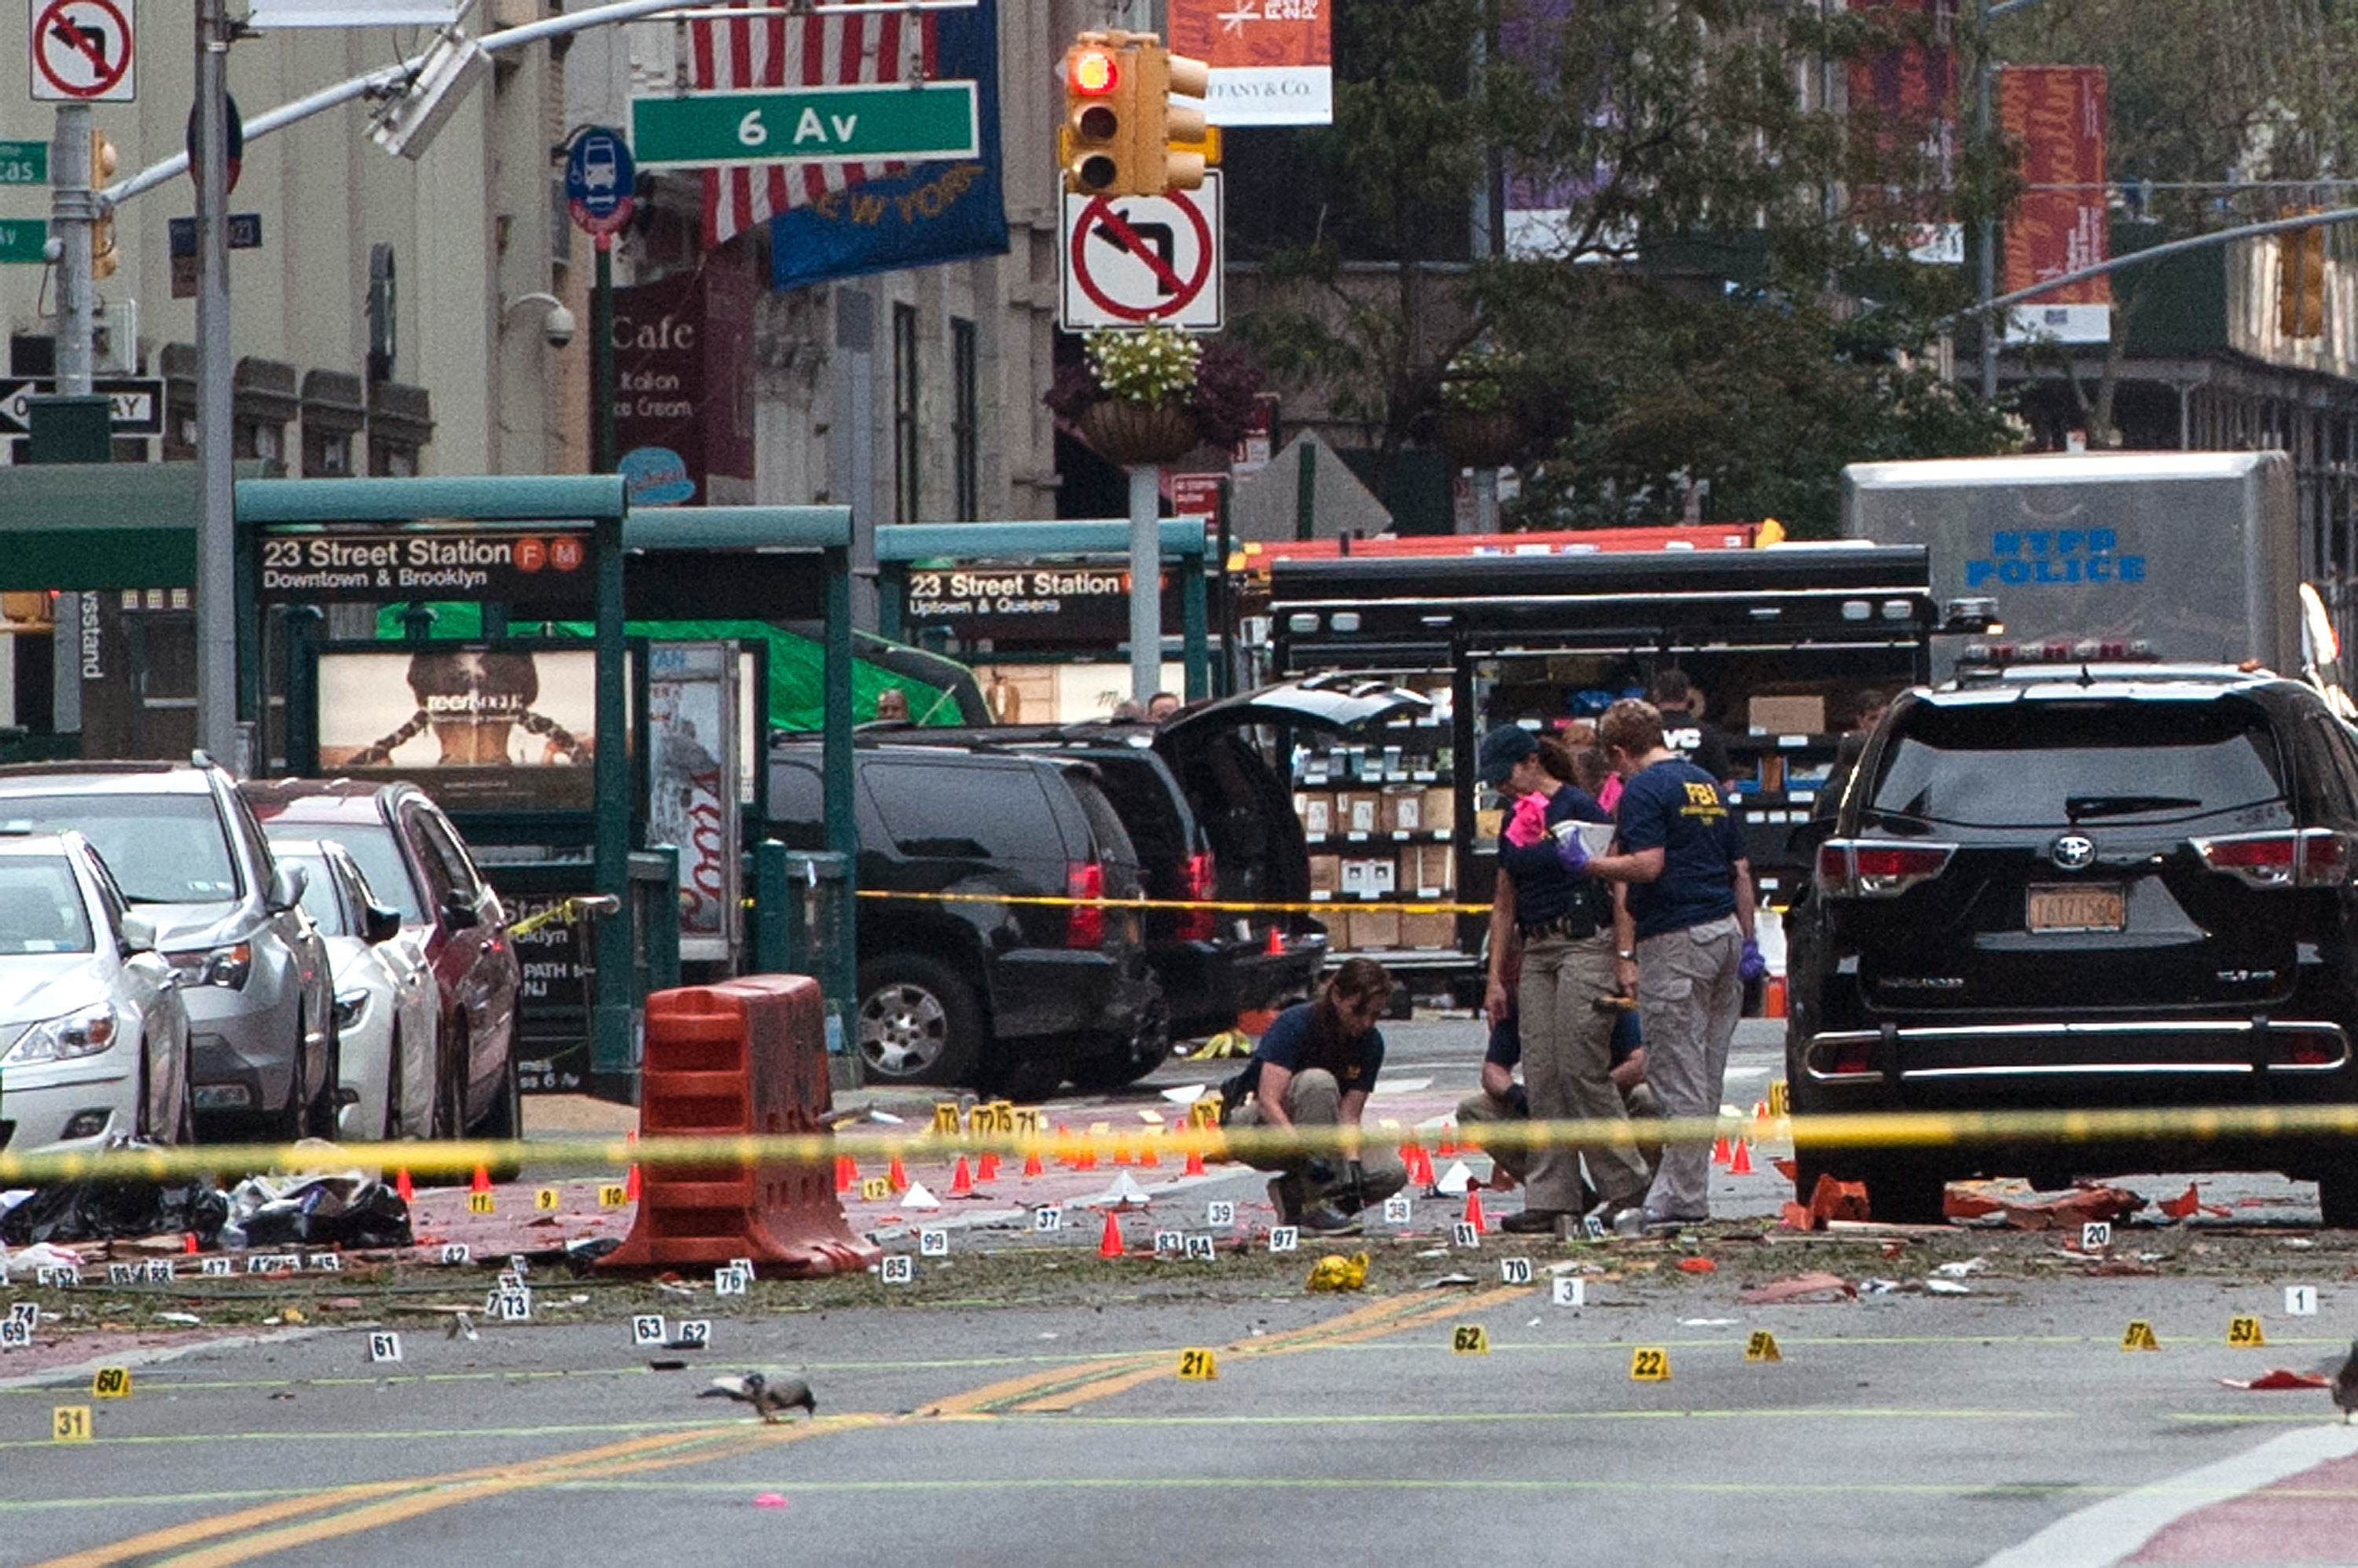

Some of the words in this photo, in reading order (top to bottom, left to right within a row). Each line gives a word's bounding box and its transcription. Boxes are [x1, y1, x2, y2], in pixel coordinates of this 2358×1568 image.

[1208, 82, 1261, 98] FFANY
[737, 109, 768, 146] 6
[792, 107, 858, 145] Av
[264, 542, 300, 567] 23
[309, 541, 399, 567] Street
[408, 539, 511, 566] Station
[263, 571, 369, 589] Downtown
[376, 569, 390, 586] &
[399, 569, 487, 589] Brooklyn
[1966, 555, 2146, 587] POLICE
[909, 575, 942, 597] 23
[950, 573, 1024, 597] Street
[1034, 572, 1118, 595] Station
[909, 600, 972, 616] Uptown
[996, 597, 1060, 613] Queens
[1684, 781, 1720, 805] FBI
[523, 963, 567, 979] PATH
[523, 981, 548, 997] NJ
[604, 1188, 623, 1204] 10
[867, 1181, 886, 1196] 12
[472, 1195, 487, 1211] 11
[542, 1191, 552, 1207] 9
[1038, 1210, 1058, 1228] 37
[1211, 1205, 1231, 1222] 39
[1273, 1229, 1295, 1247] 97
[2086, 1225, 2107, 1244] 20
[1189, 1239, 1211, 1257] 84
[885, 1260, 907, 1277] 85
[1504, 1261, 1529, 1280] 70
[720, 1270, 741, 1290] 76
[1562, 1281, 1574, 1301] 3
[2294, 1289, 2304, 1310] 1
[503, 1295, 526, 1316] 73
[2, 1320, 25, 1342] 69
[637, 1316, 662, 1339] 63
[682, 1323, 707, 1341] 62
[2229, 1319, 2254, 1342] 53
[373, 1335, 395, 1357] 61
[1453, 1326, 1480, 1351] 62
[1181, 1350, 1205, 1375] 21
[1634, 1350, 1662, 1375] 22
[97, 1369, 124, 1393] 60
[58, 1410, 83, 1435] 31
